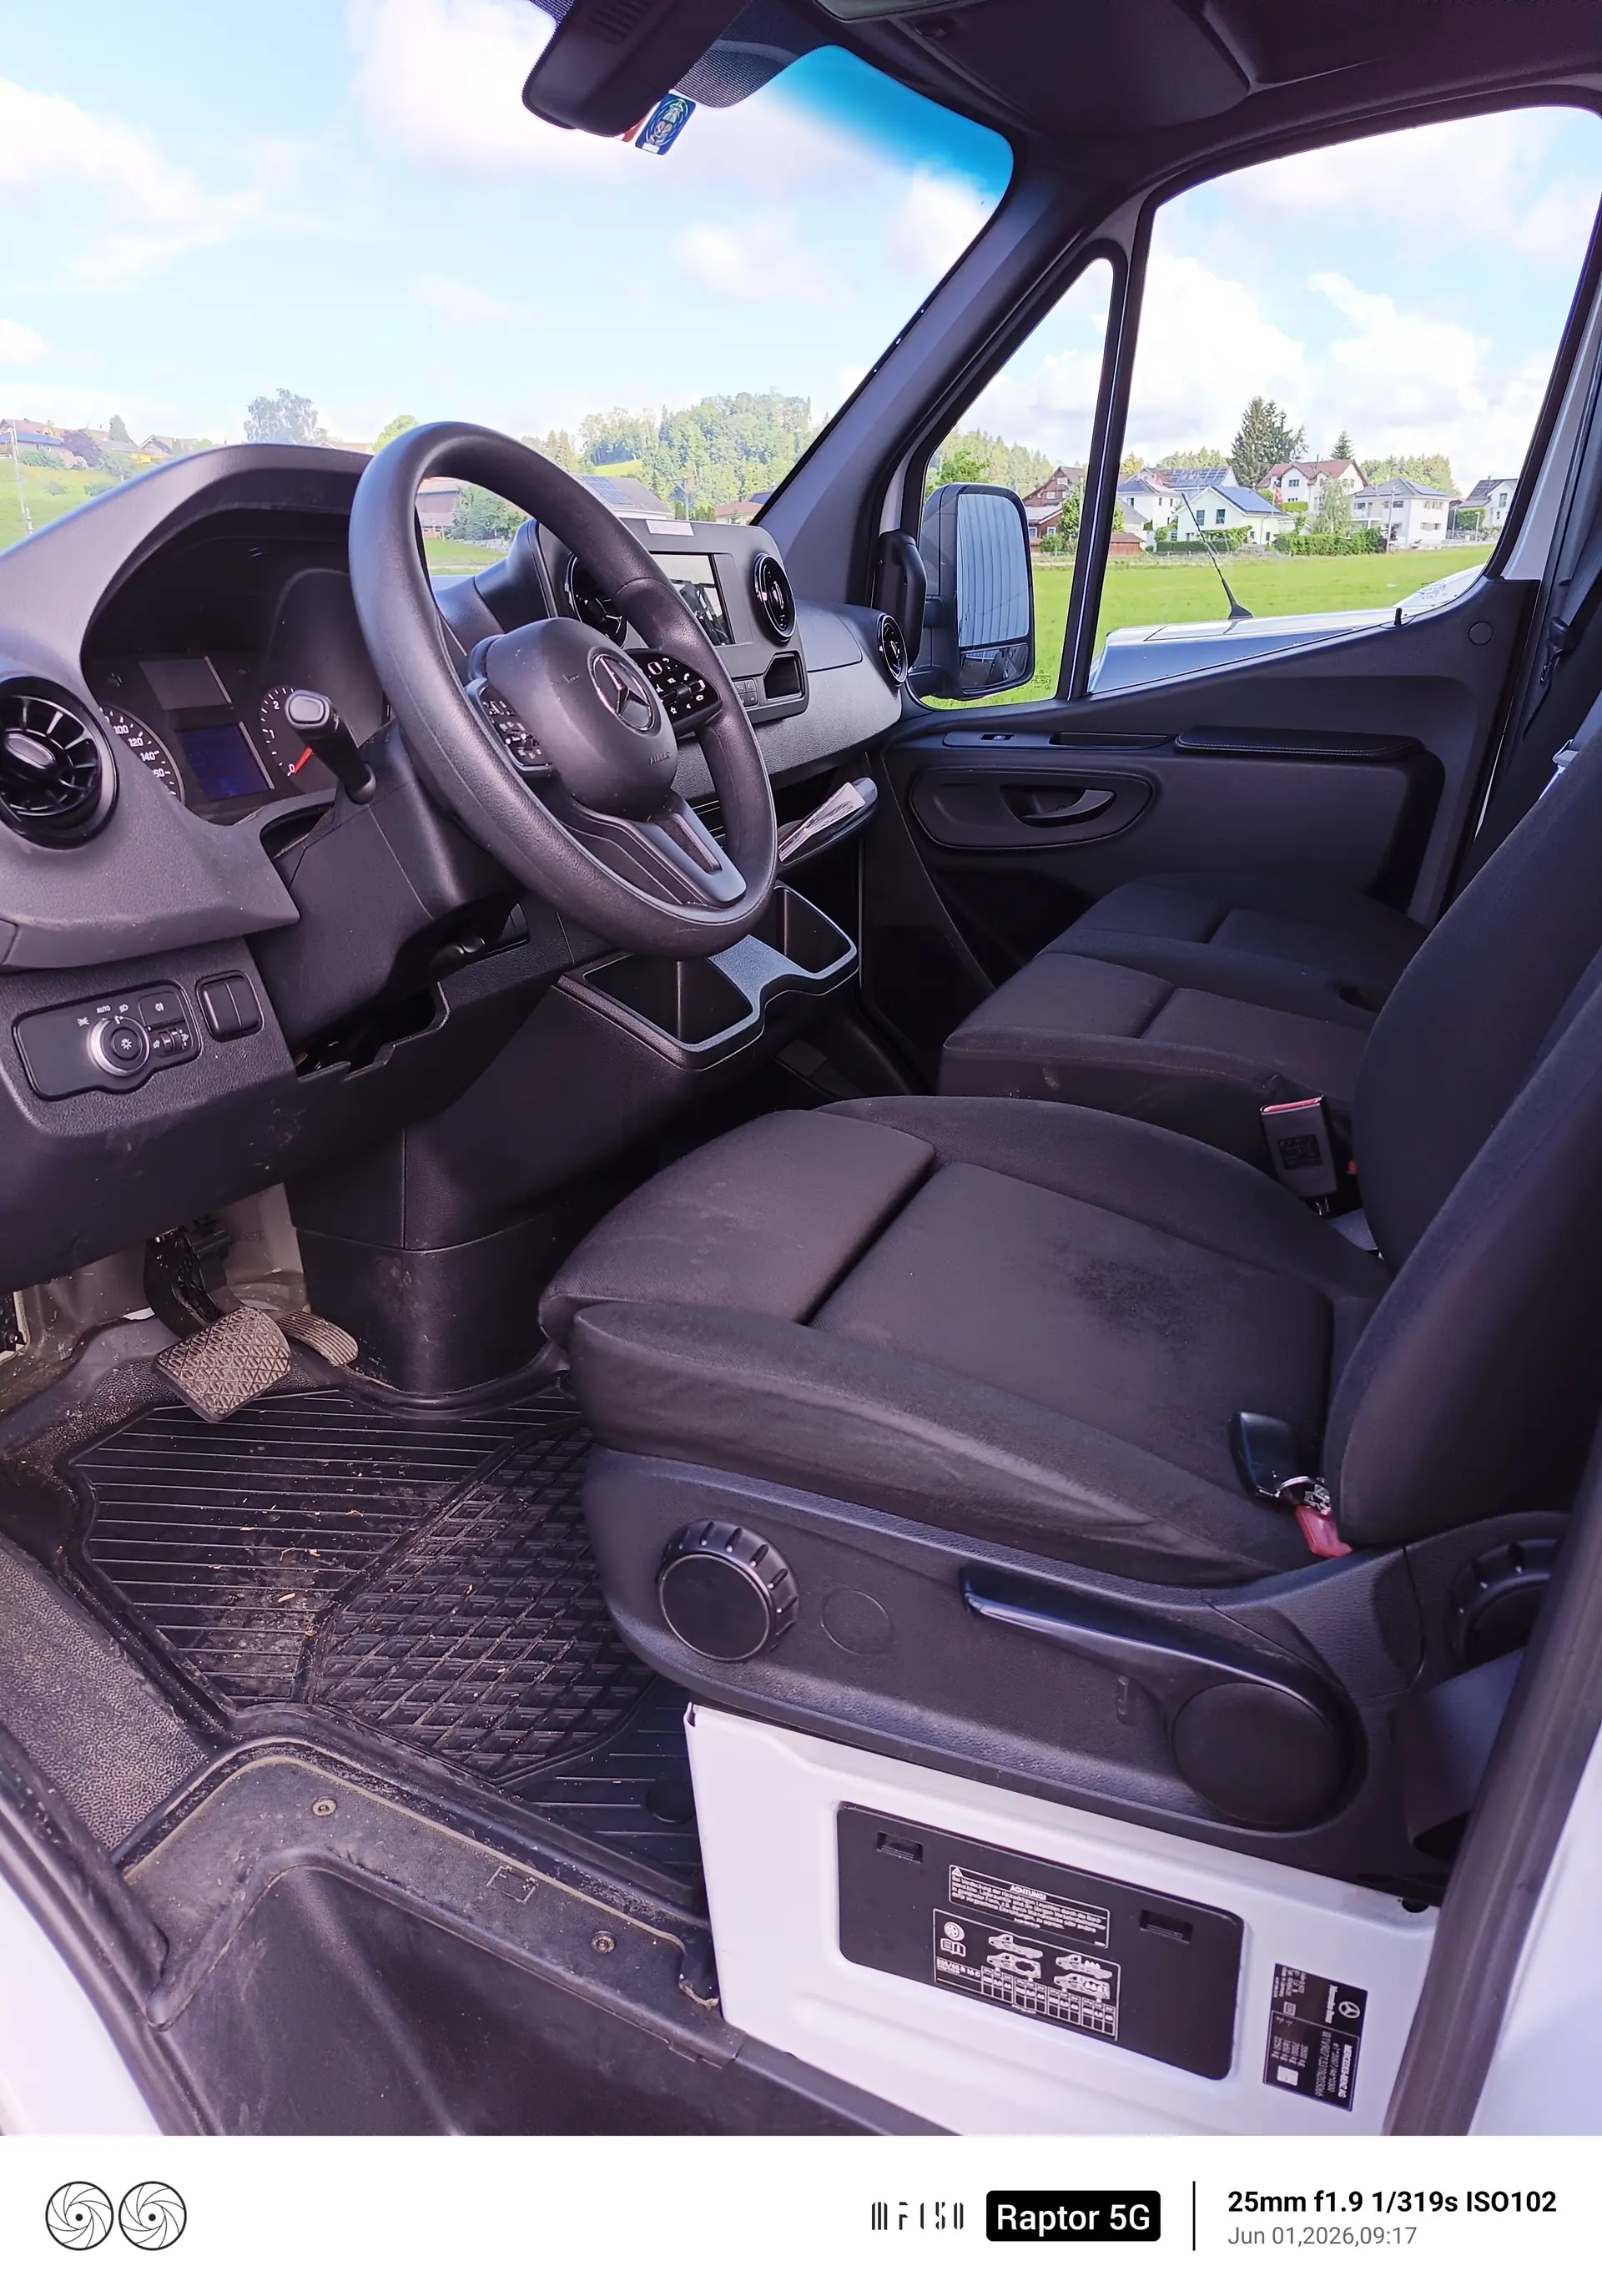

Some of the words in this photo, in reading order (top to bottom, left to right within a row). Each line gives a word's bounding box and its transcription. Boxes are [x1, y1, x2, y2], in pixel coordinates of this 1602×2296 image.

[273, 700, 280, 710] 2
[113, 724, 129, 735] 100
[270, 729, 275, 739] 1
[128, 737, 144, 748] 120
[140, 751, 156, 762] 140
[289, 763, 295, 773] 0
[96, 1004, 111, 1014] AUTO
